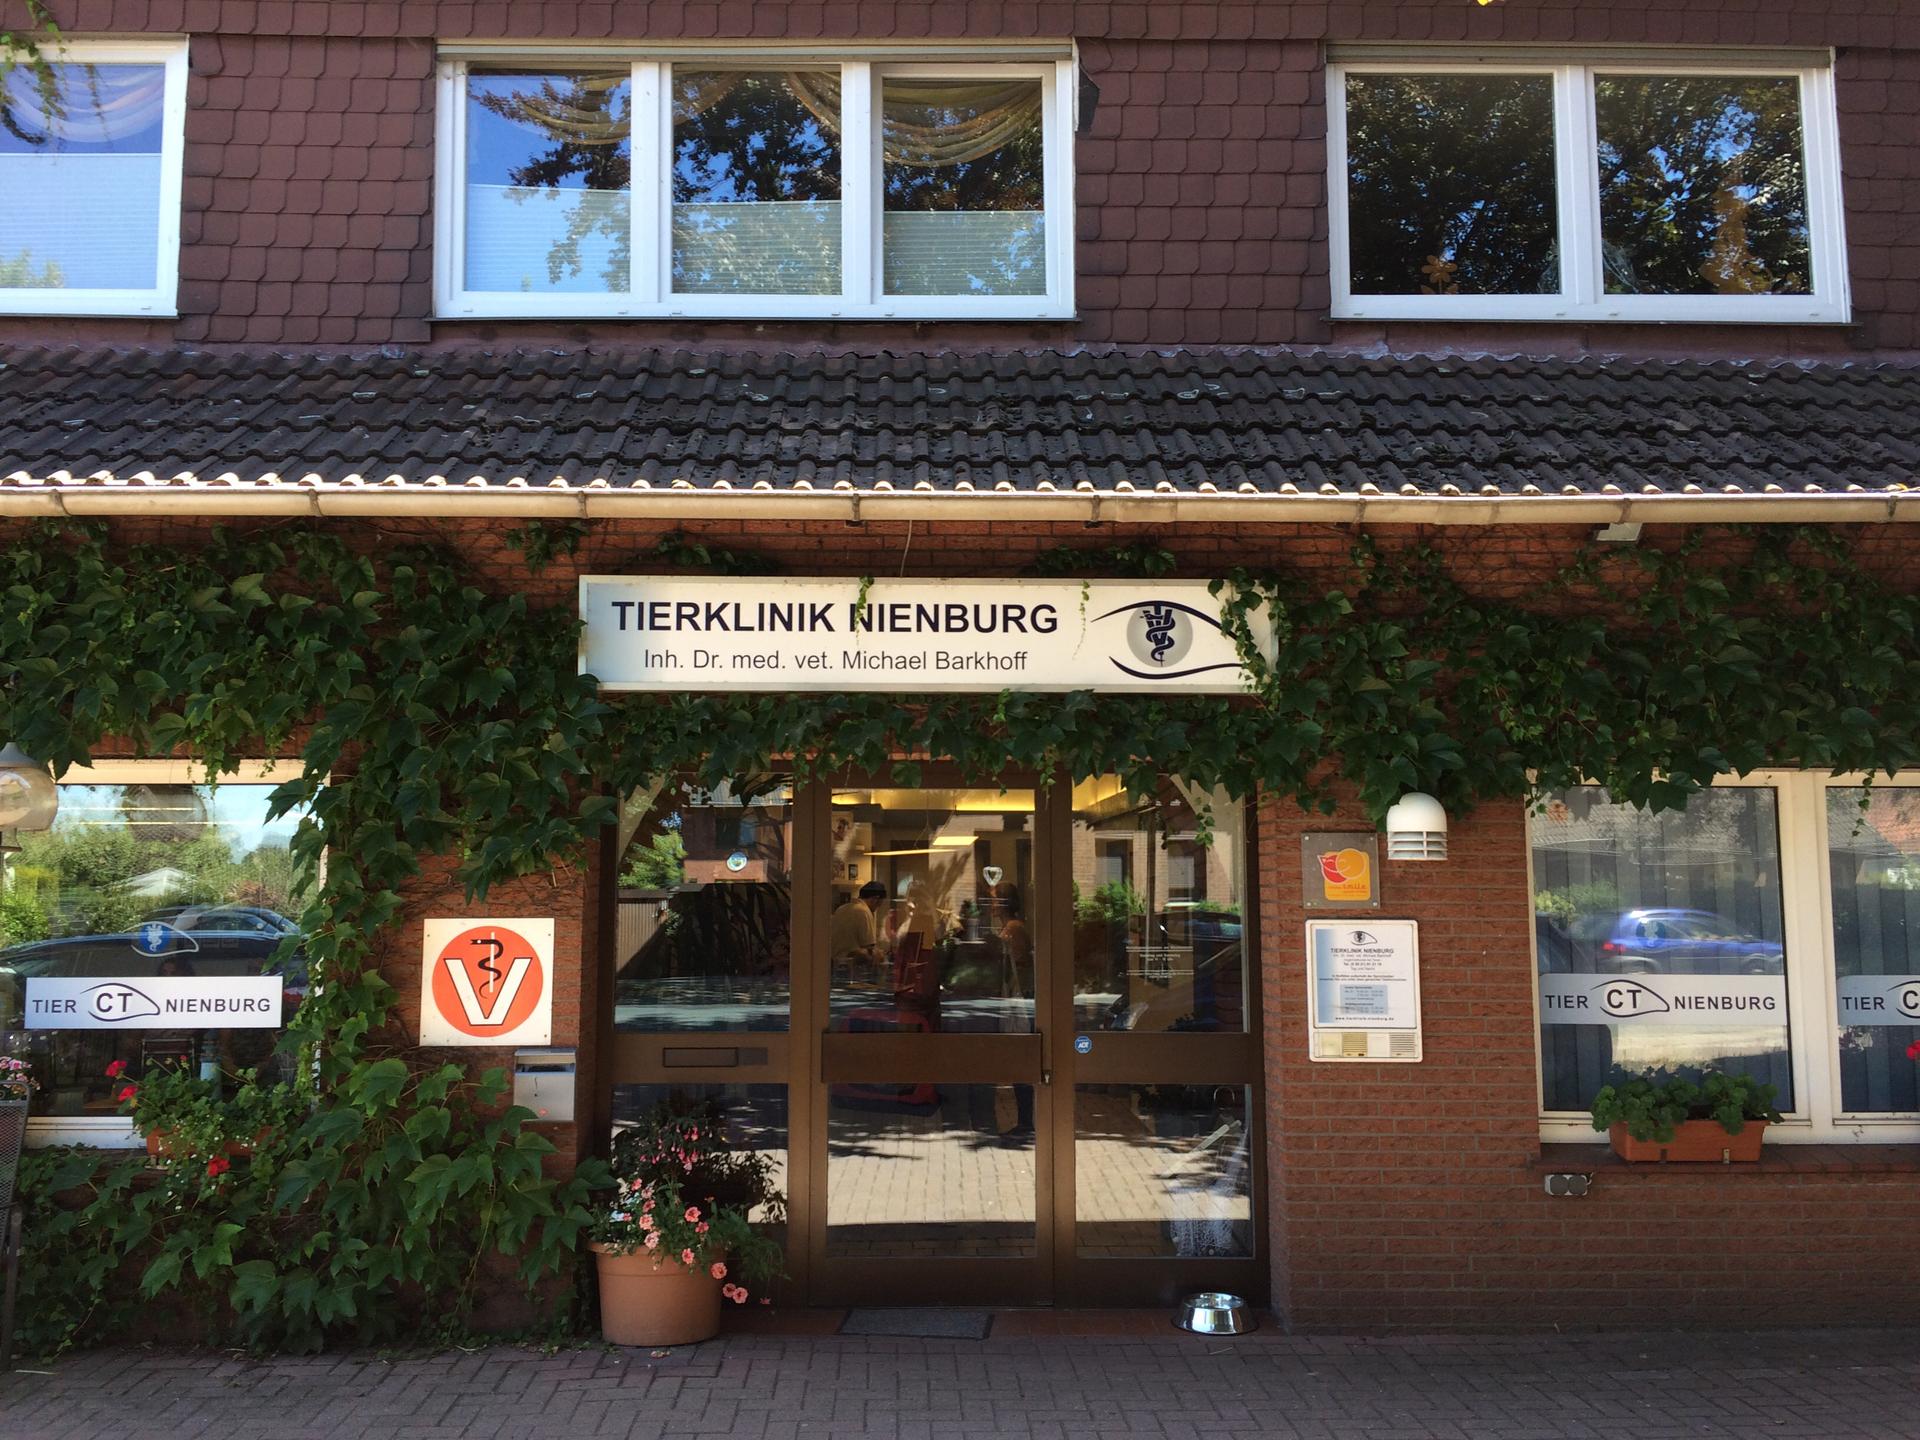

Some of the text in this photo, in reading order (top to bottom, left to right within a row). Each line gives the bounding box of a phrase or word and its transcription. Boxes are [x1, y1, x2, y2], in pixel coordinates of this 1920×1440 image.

[611, 601, 1058, 634] TIERKLINIK NIENBURG
[644, 649, 1028, 670] Inh. Dr. med. vet. Michael Barkhoff
[32, 993, 271, 1013] TIER CT NIENBURG
[1545, 989, 1776, 1010] TIER CT NIENBURG
[1842, 996, 1885, 1010] TIER
